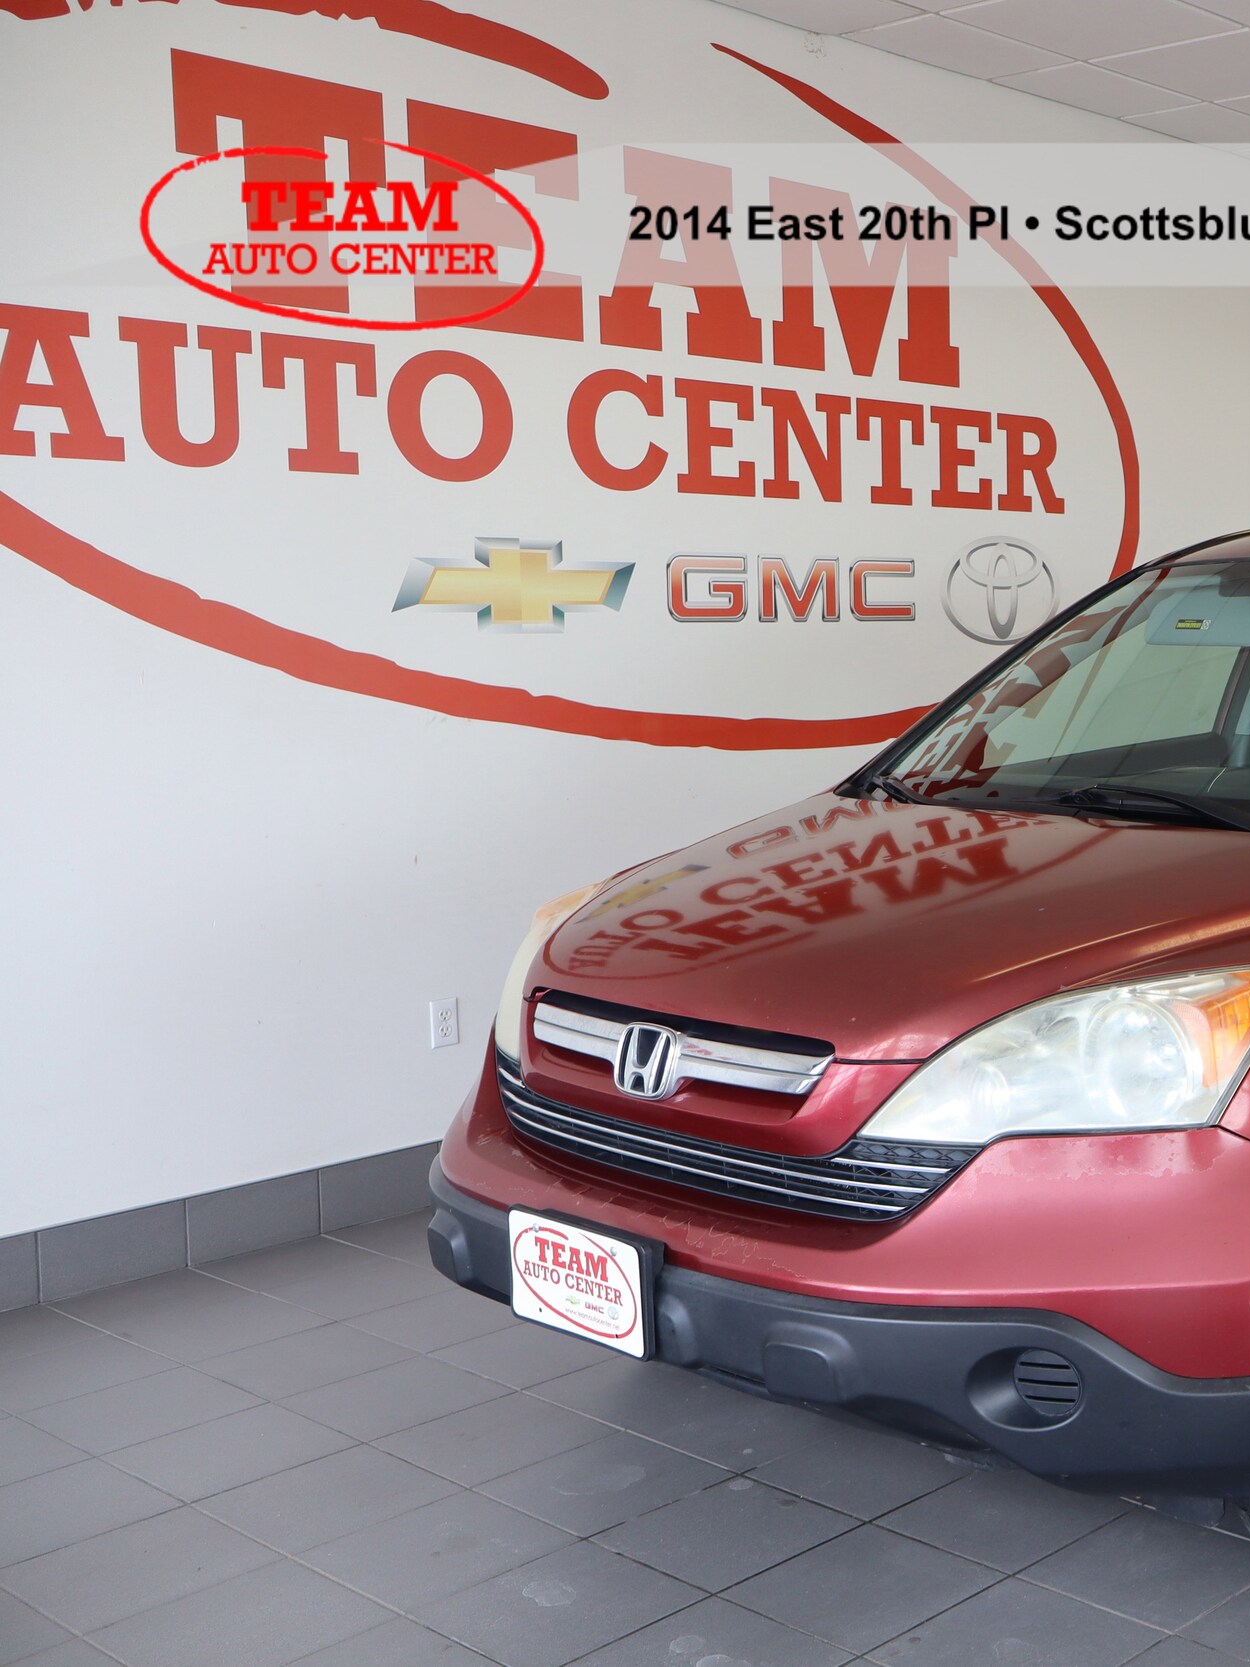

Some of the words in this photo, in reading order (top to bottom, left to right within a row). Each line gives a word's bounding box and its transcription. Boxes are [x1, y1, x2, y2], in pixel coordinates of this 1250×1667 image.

[171, 48, 960, 388] TEAM
[0, 303, 514, 483] AUTO
[566, 368, 1065, 514] CENTER
[666, 552, 916, 623] GMC
[523, 1259, 561, 1285] AUTO
[564, 1273, 623, 1307] CENTER
[534, 1236, 609, 1283] TEAM
